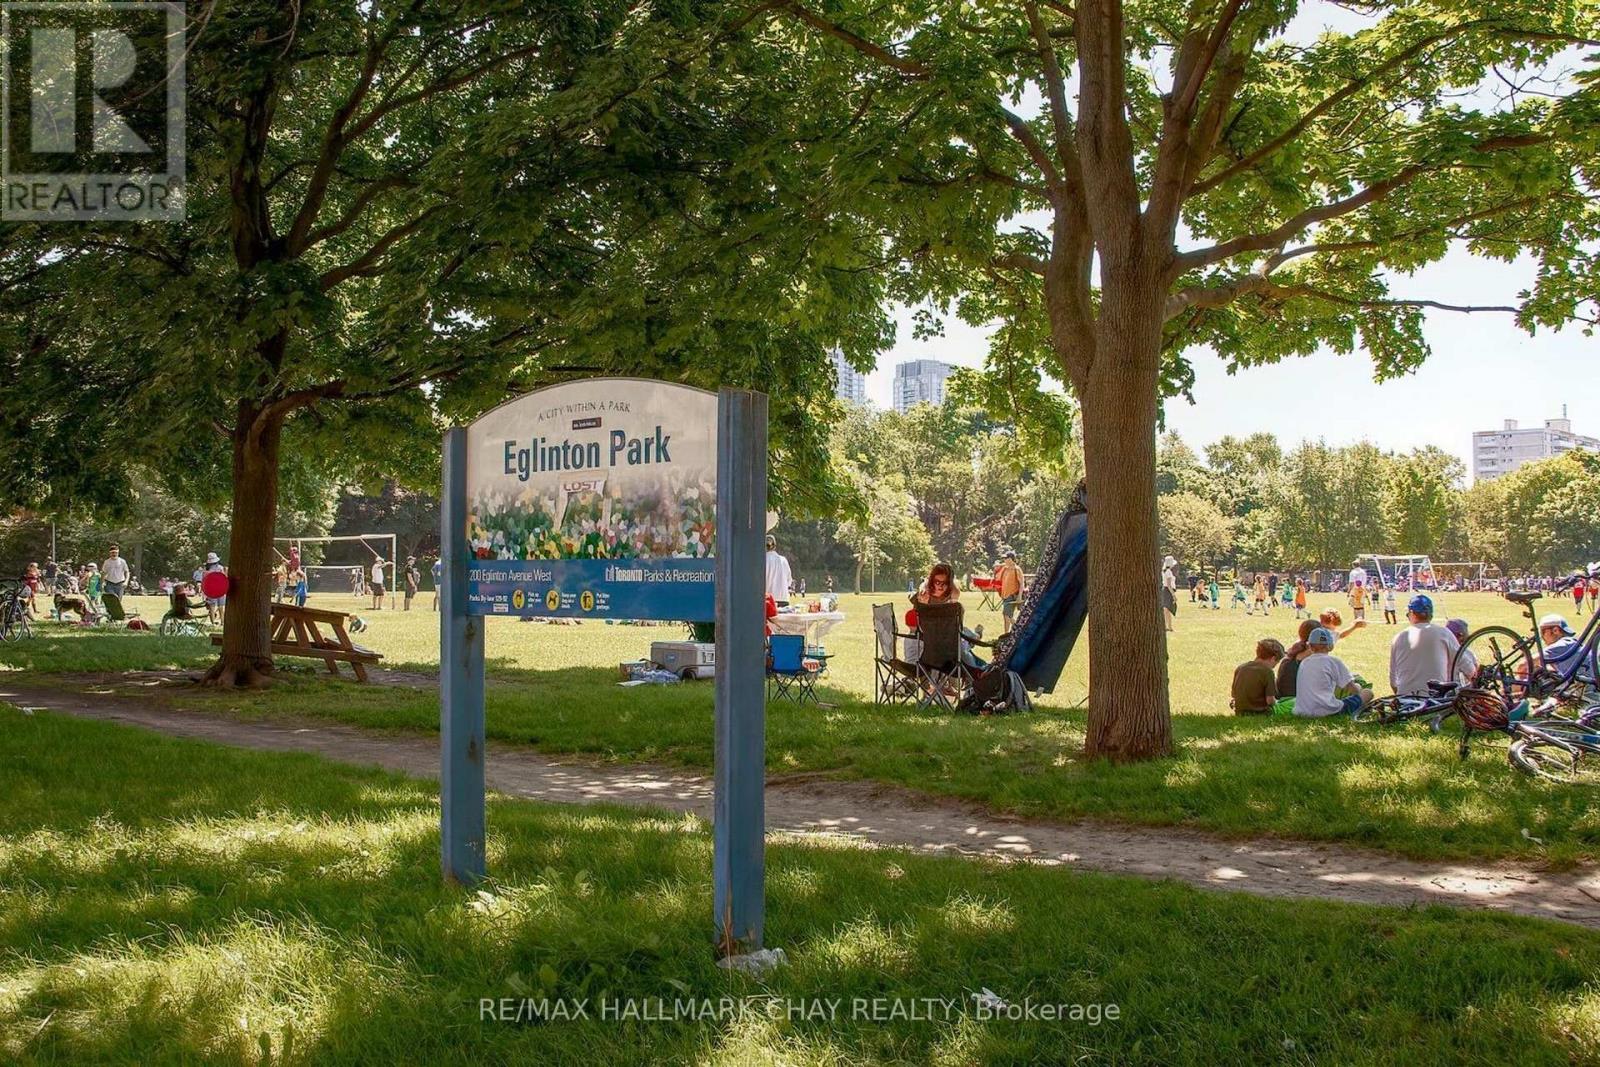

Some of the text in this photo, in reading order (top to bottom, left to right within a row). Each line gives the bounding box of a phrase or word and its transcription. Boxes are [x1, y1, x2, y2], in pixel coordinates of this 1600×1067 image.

[537, 400, 631, 422] A CITY WITHIN A PARK
[504, 425, 672, 482] Eglinton Park
[563, 480, 598, 492] LOST
[482, 569, 507, 583] Eglinton
[508, 569, 532, 581] Avenue
[533, 569, 552, 581] West
[615, 566, 715, 582] TORONTO Parks & Recreation
